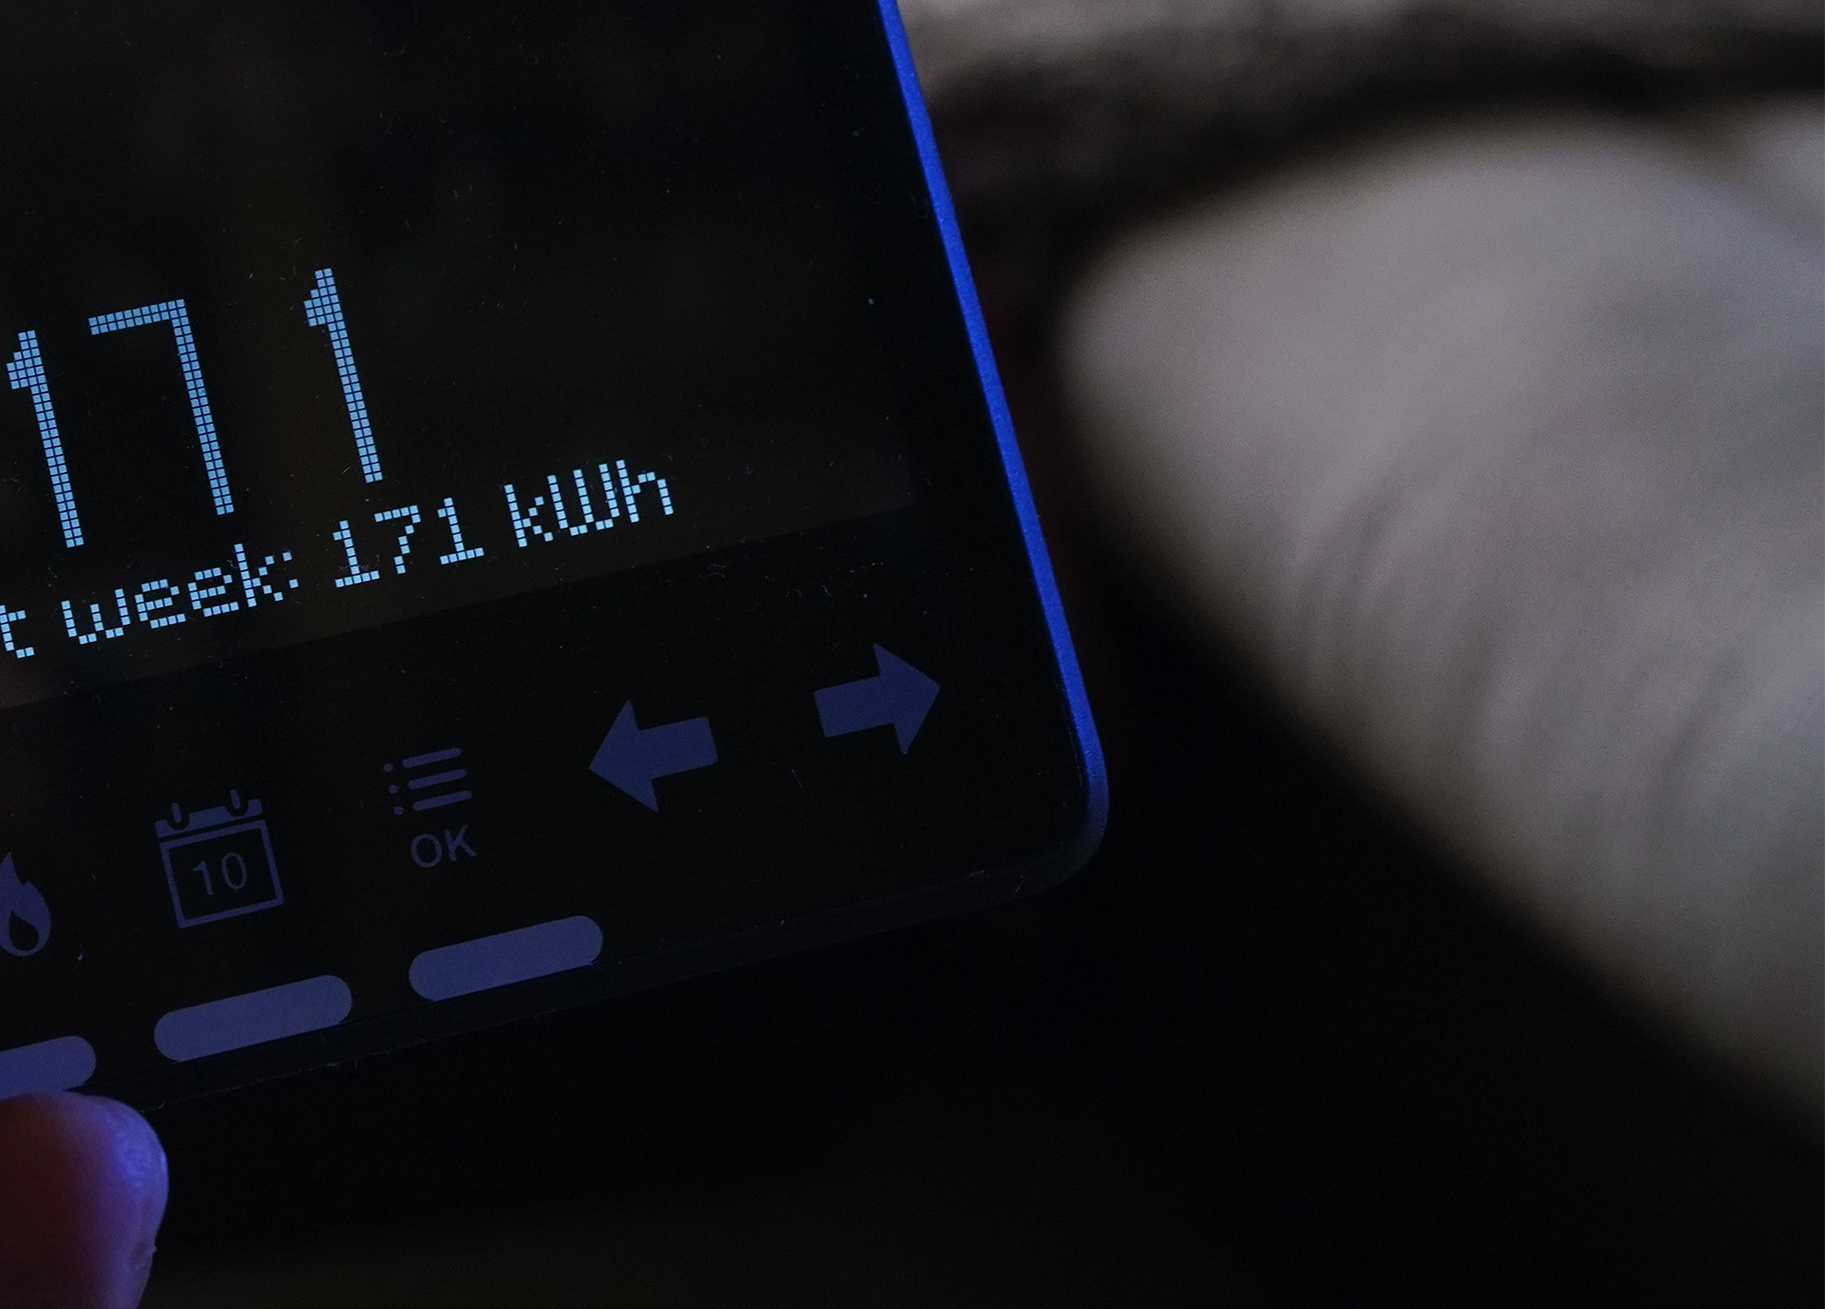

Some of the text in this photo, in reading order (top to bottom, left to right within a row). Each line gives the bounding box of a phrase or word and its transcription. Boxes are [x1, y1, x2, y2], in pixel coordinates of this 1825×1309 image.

[60, 543, 299, 645] week:
[332, 497, 485, 588] 171
[503, 459, 674, 548] kWh
[408, 823, 479, 870] OK
[192, 850, 249, 896] 10
